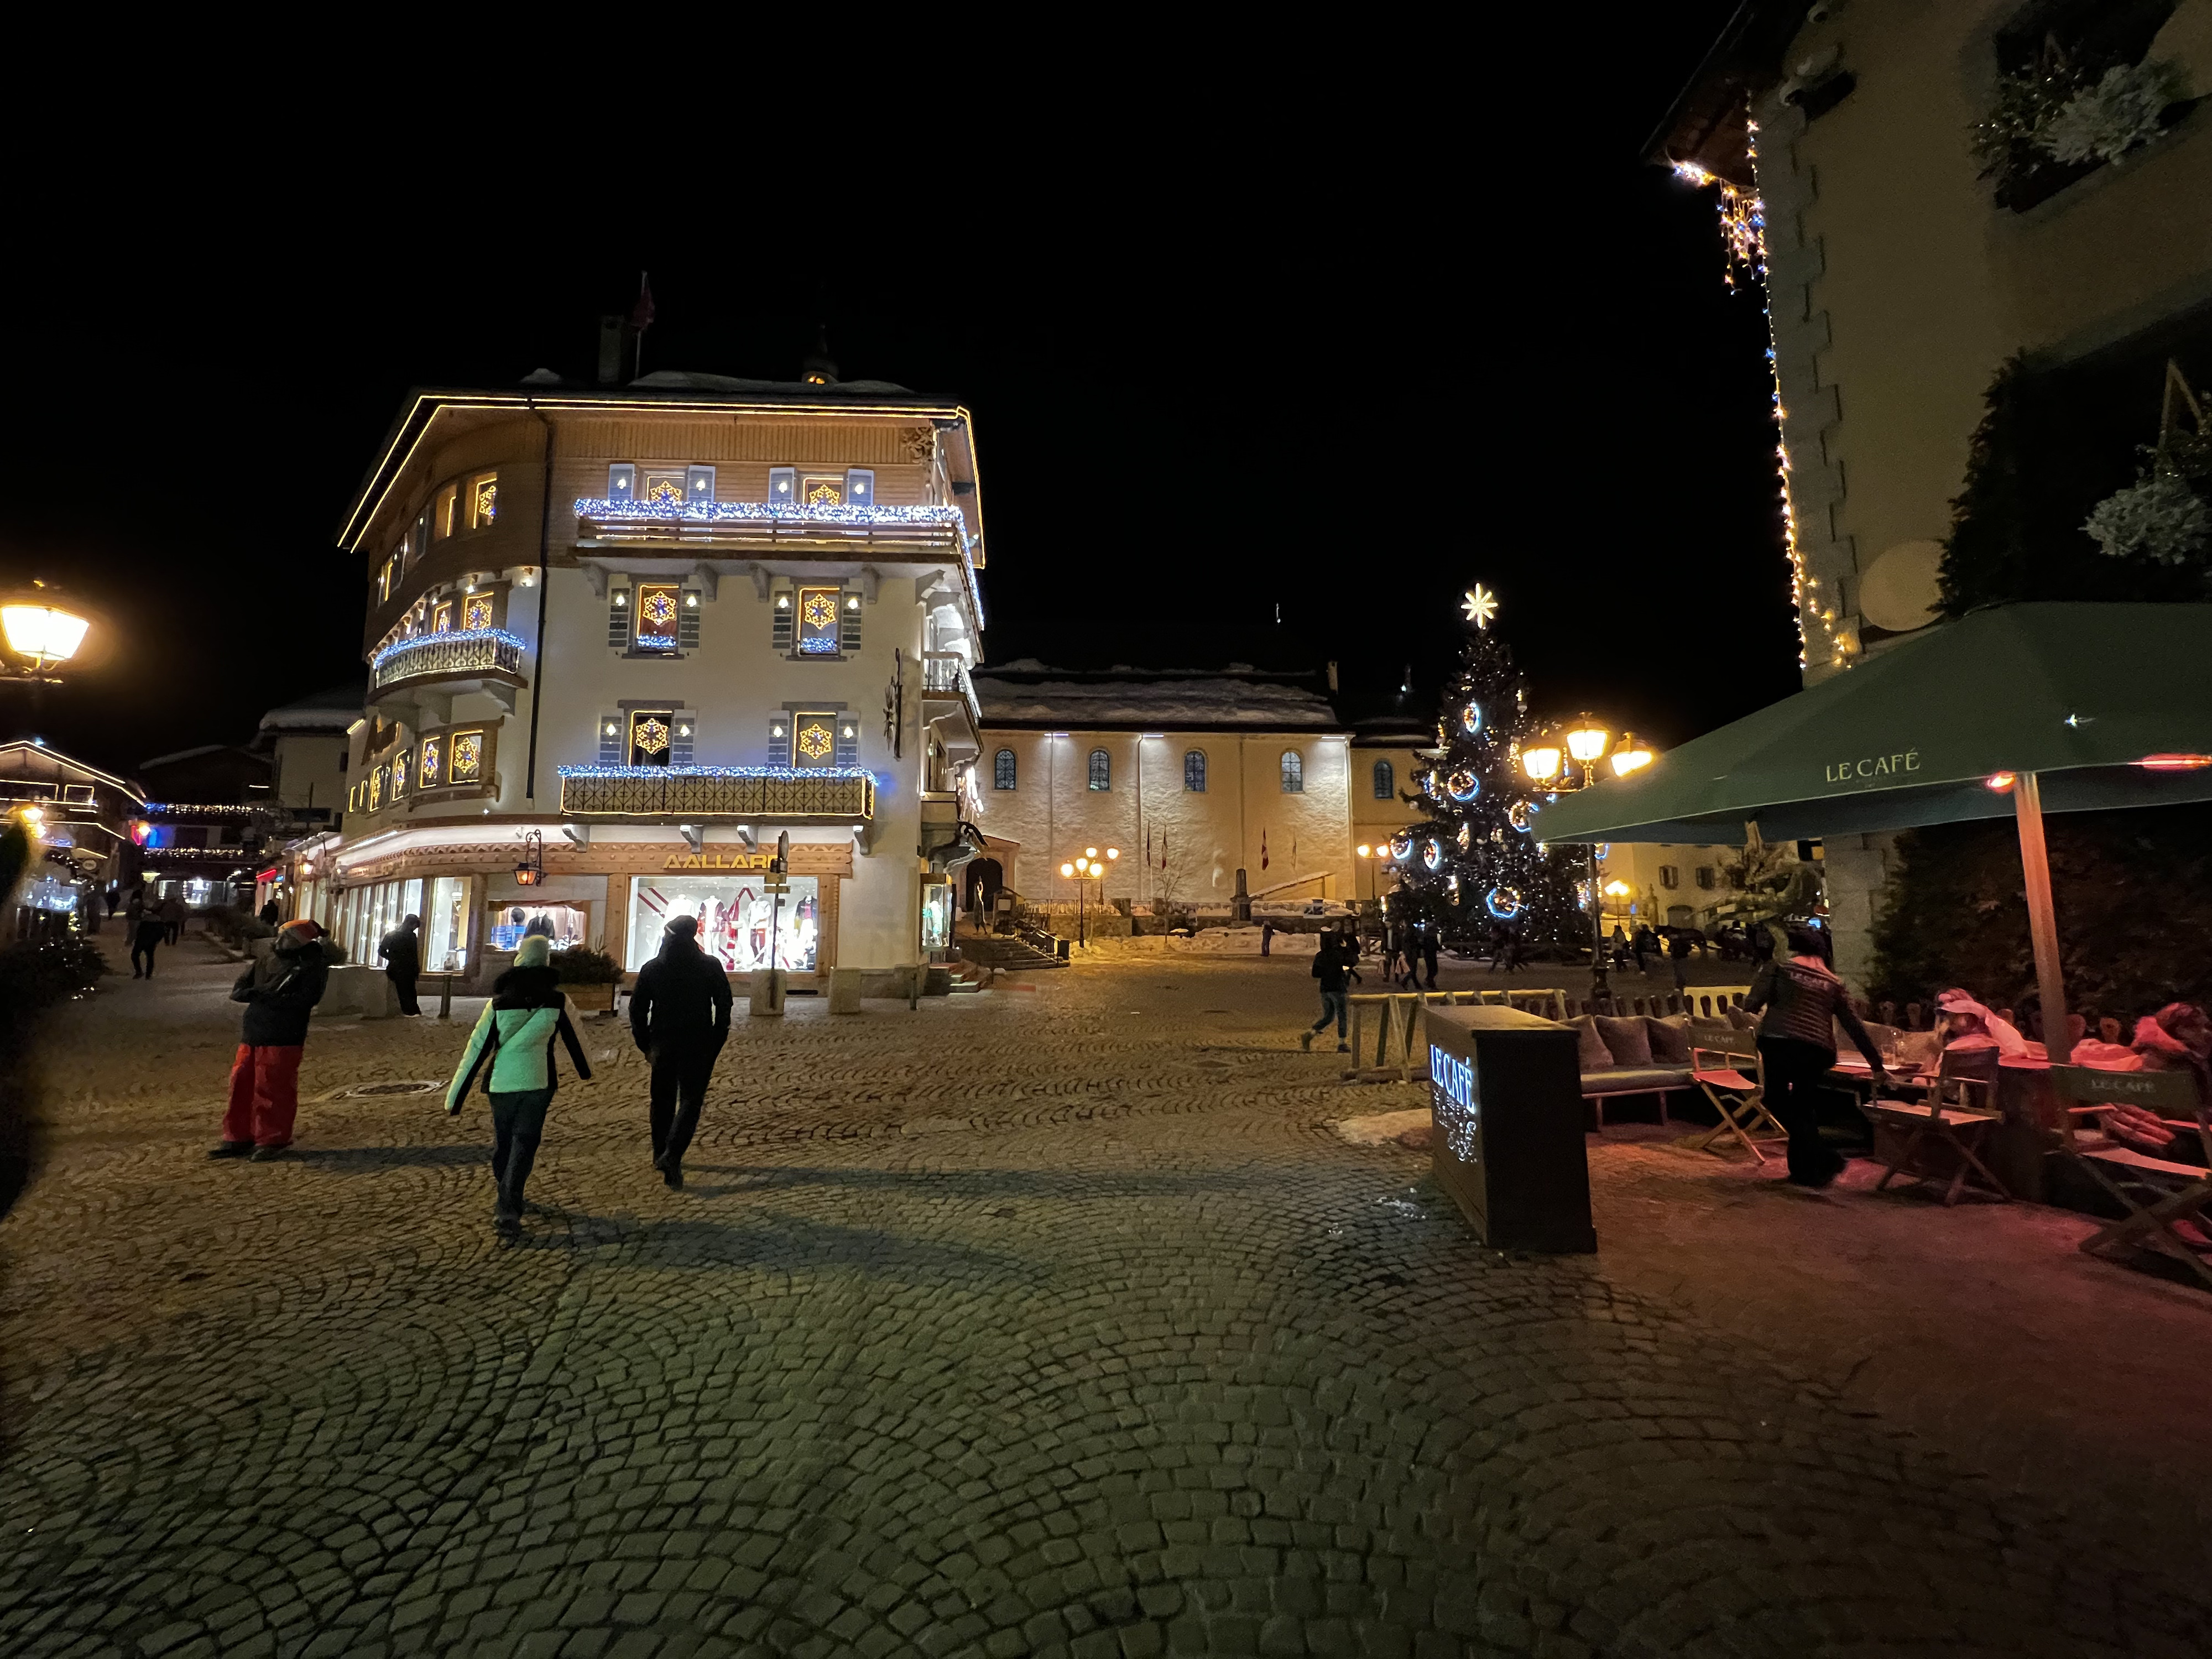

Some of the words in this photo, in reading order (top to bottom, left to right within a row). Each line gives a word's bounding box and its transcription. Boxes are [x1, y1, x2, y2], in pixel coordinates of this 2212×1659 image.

[1826, 762, 1852, 782] LE
[1856, 747, 1921, 776] CAFÉ
[1430, 1044, 1444, 1088] LE
[1443, 1053, 1475, 1115] CAFÉ
